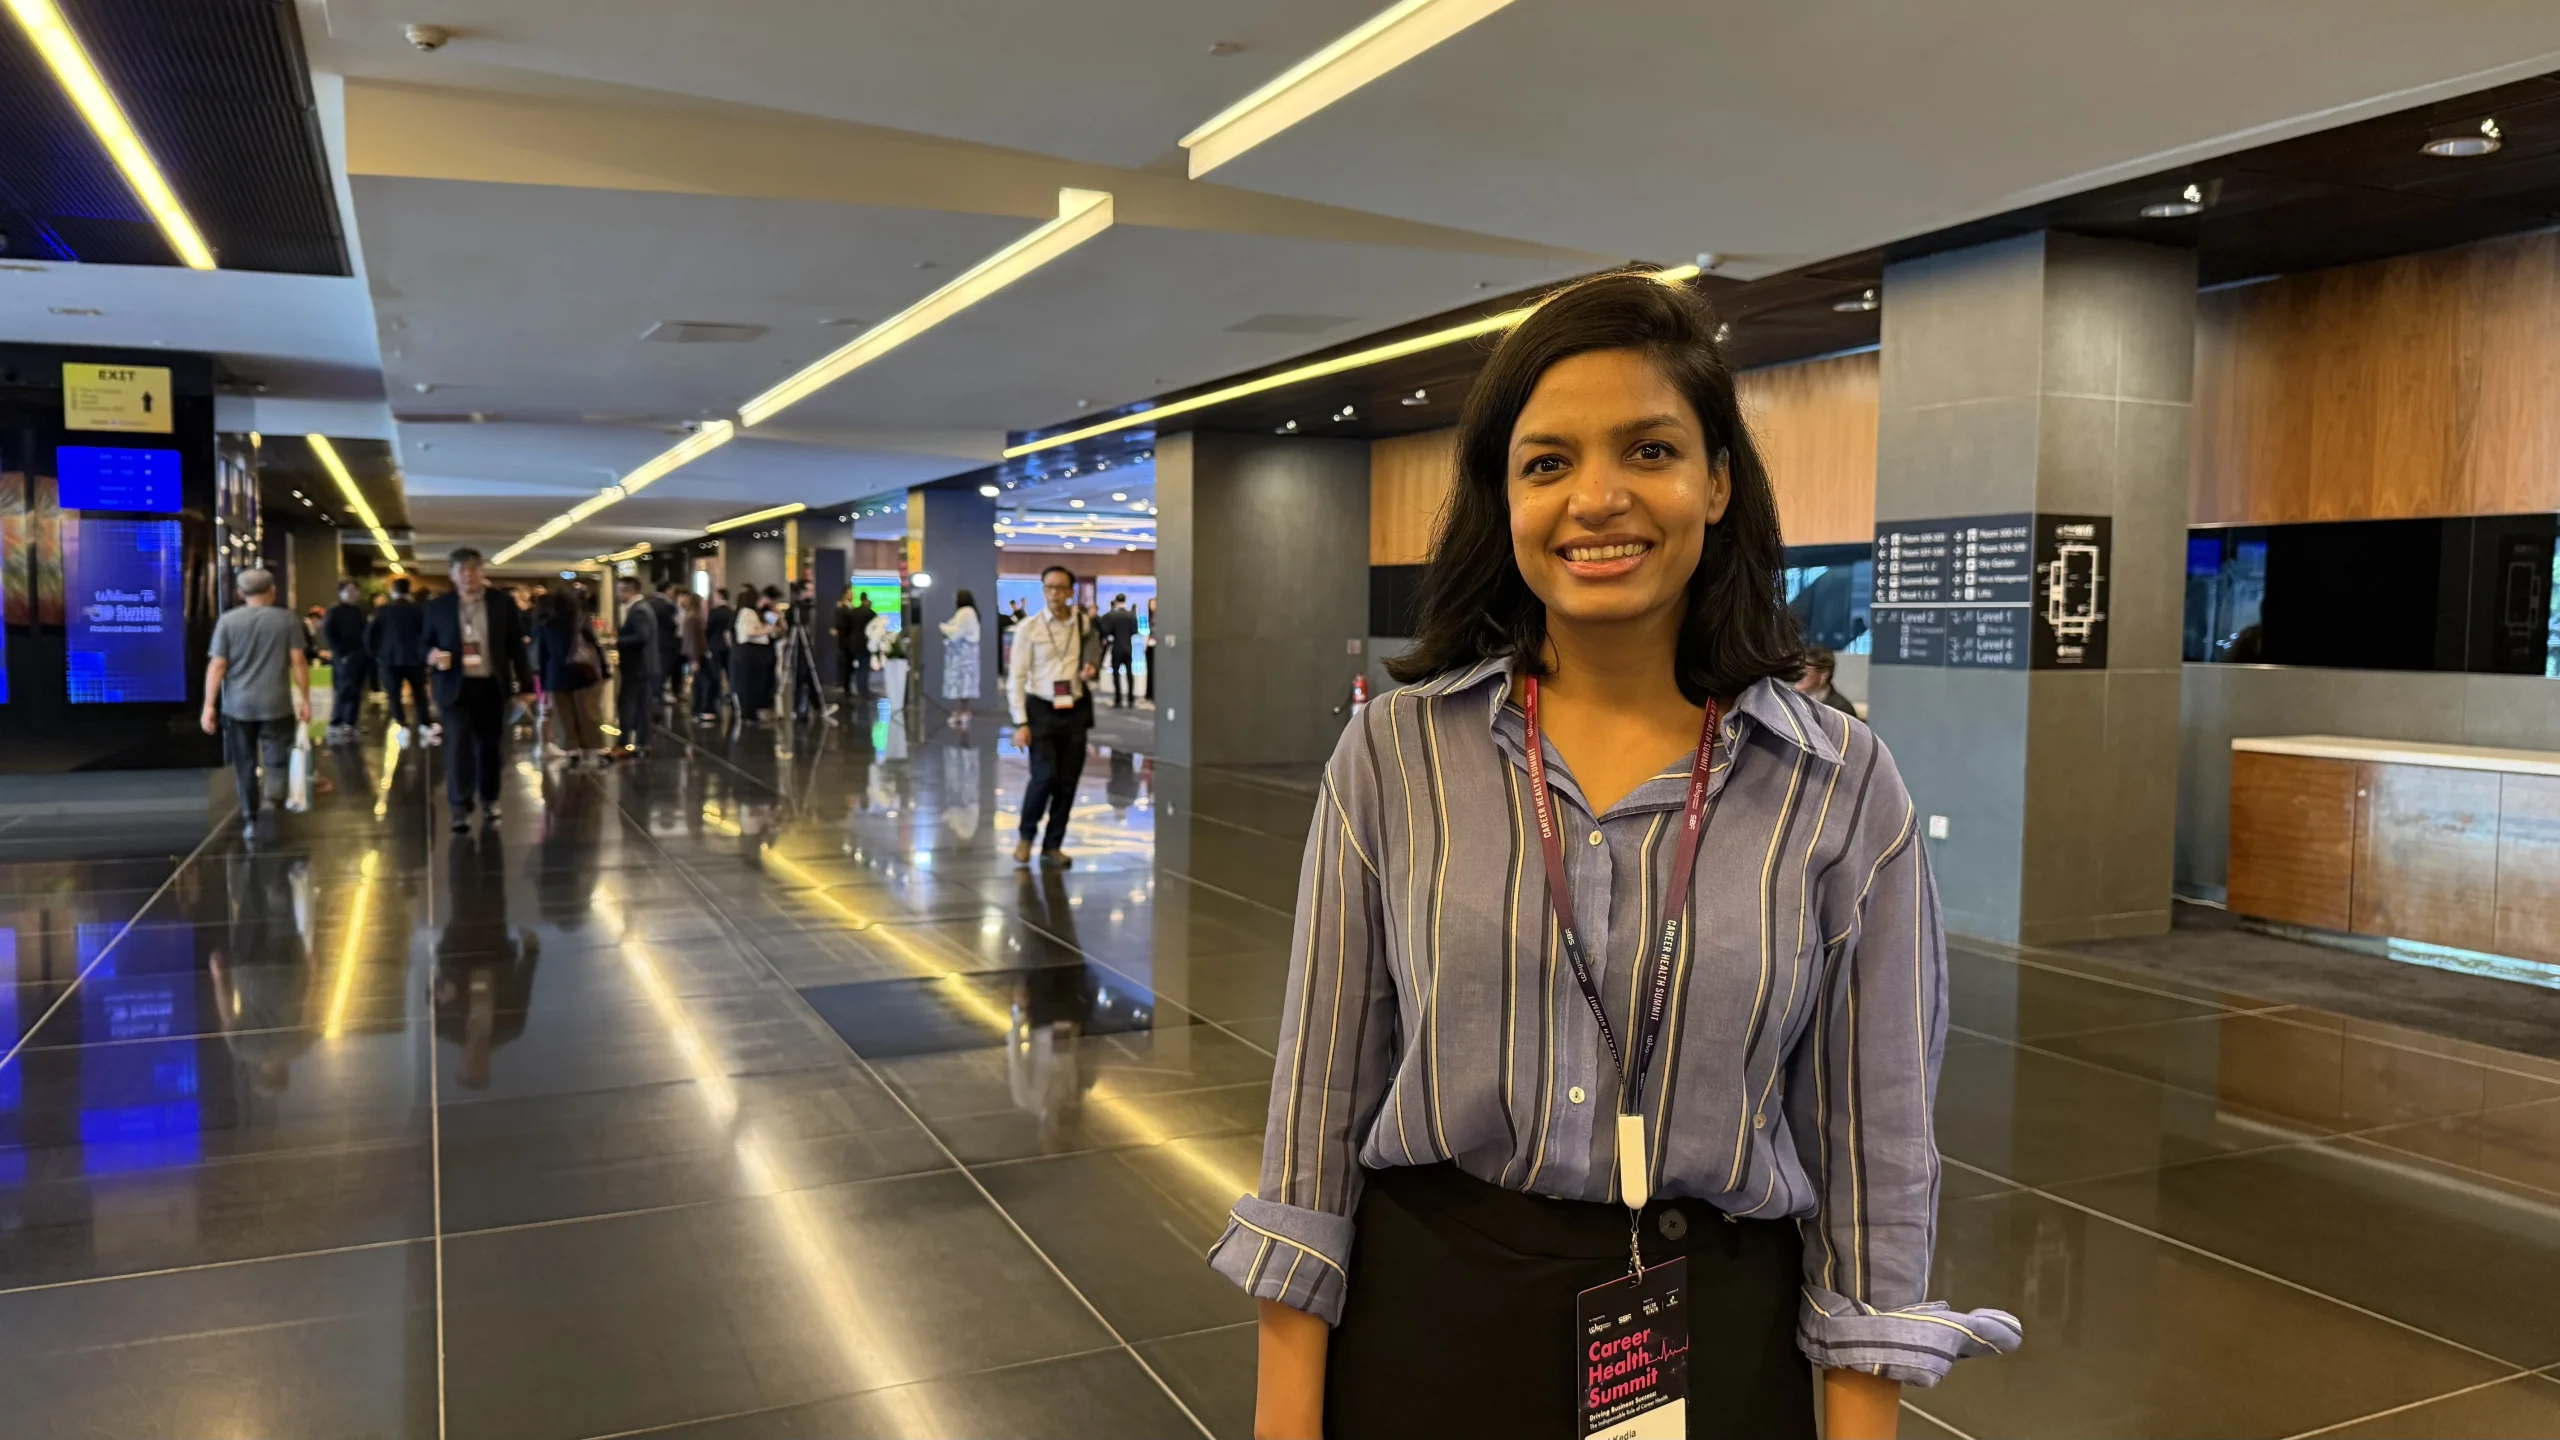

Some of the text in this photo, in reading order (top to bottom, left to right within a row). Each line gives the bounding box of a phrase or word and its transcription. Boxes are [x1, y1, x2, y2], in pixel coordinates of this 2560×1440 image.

[98, 368, 136, 382] EXIT
[1902, 533, 1920, 544] Room
[1980, 528, 1999, 539] Room
[1901, 547, 1920, 558] Room
[1979, 543, 1998, 554] Room
[1978, 557, 2018, 571] Sky Garden
[1901, 611, 1936, 623] Level 2
[1976, 610, 2013, 622] Level 1
[1976, 637, 2013, 650] Level 4
[1976, 650, 2003, 663] Level
[1706, 714, 1716, 743] HEALTH
[1699, 742, 1712, 772] SUMMIT
[1528, 748, 1551, 839] CAREER HEALTH SUMMIT
[1650, 919, 1677, 1021] CAREER HEALTH SUMMIT
[1588, 995, 1606, 1027] SUMMIT
[1618, 1313, 1632, 1325] SBF
[1588, 1328, 1651, 1362] Career
[1588, 1346, 1650, 1386] Health
[1589, 1366, 1658, 1409] Summit
[1589, 1391, 1657, 1422] Driving Business Success:
[1626, 1408, 1636, 1416] Role
[1641, 1401, 1655, 1410] Career
[1655, 1394, 1669, 1404] Health
